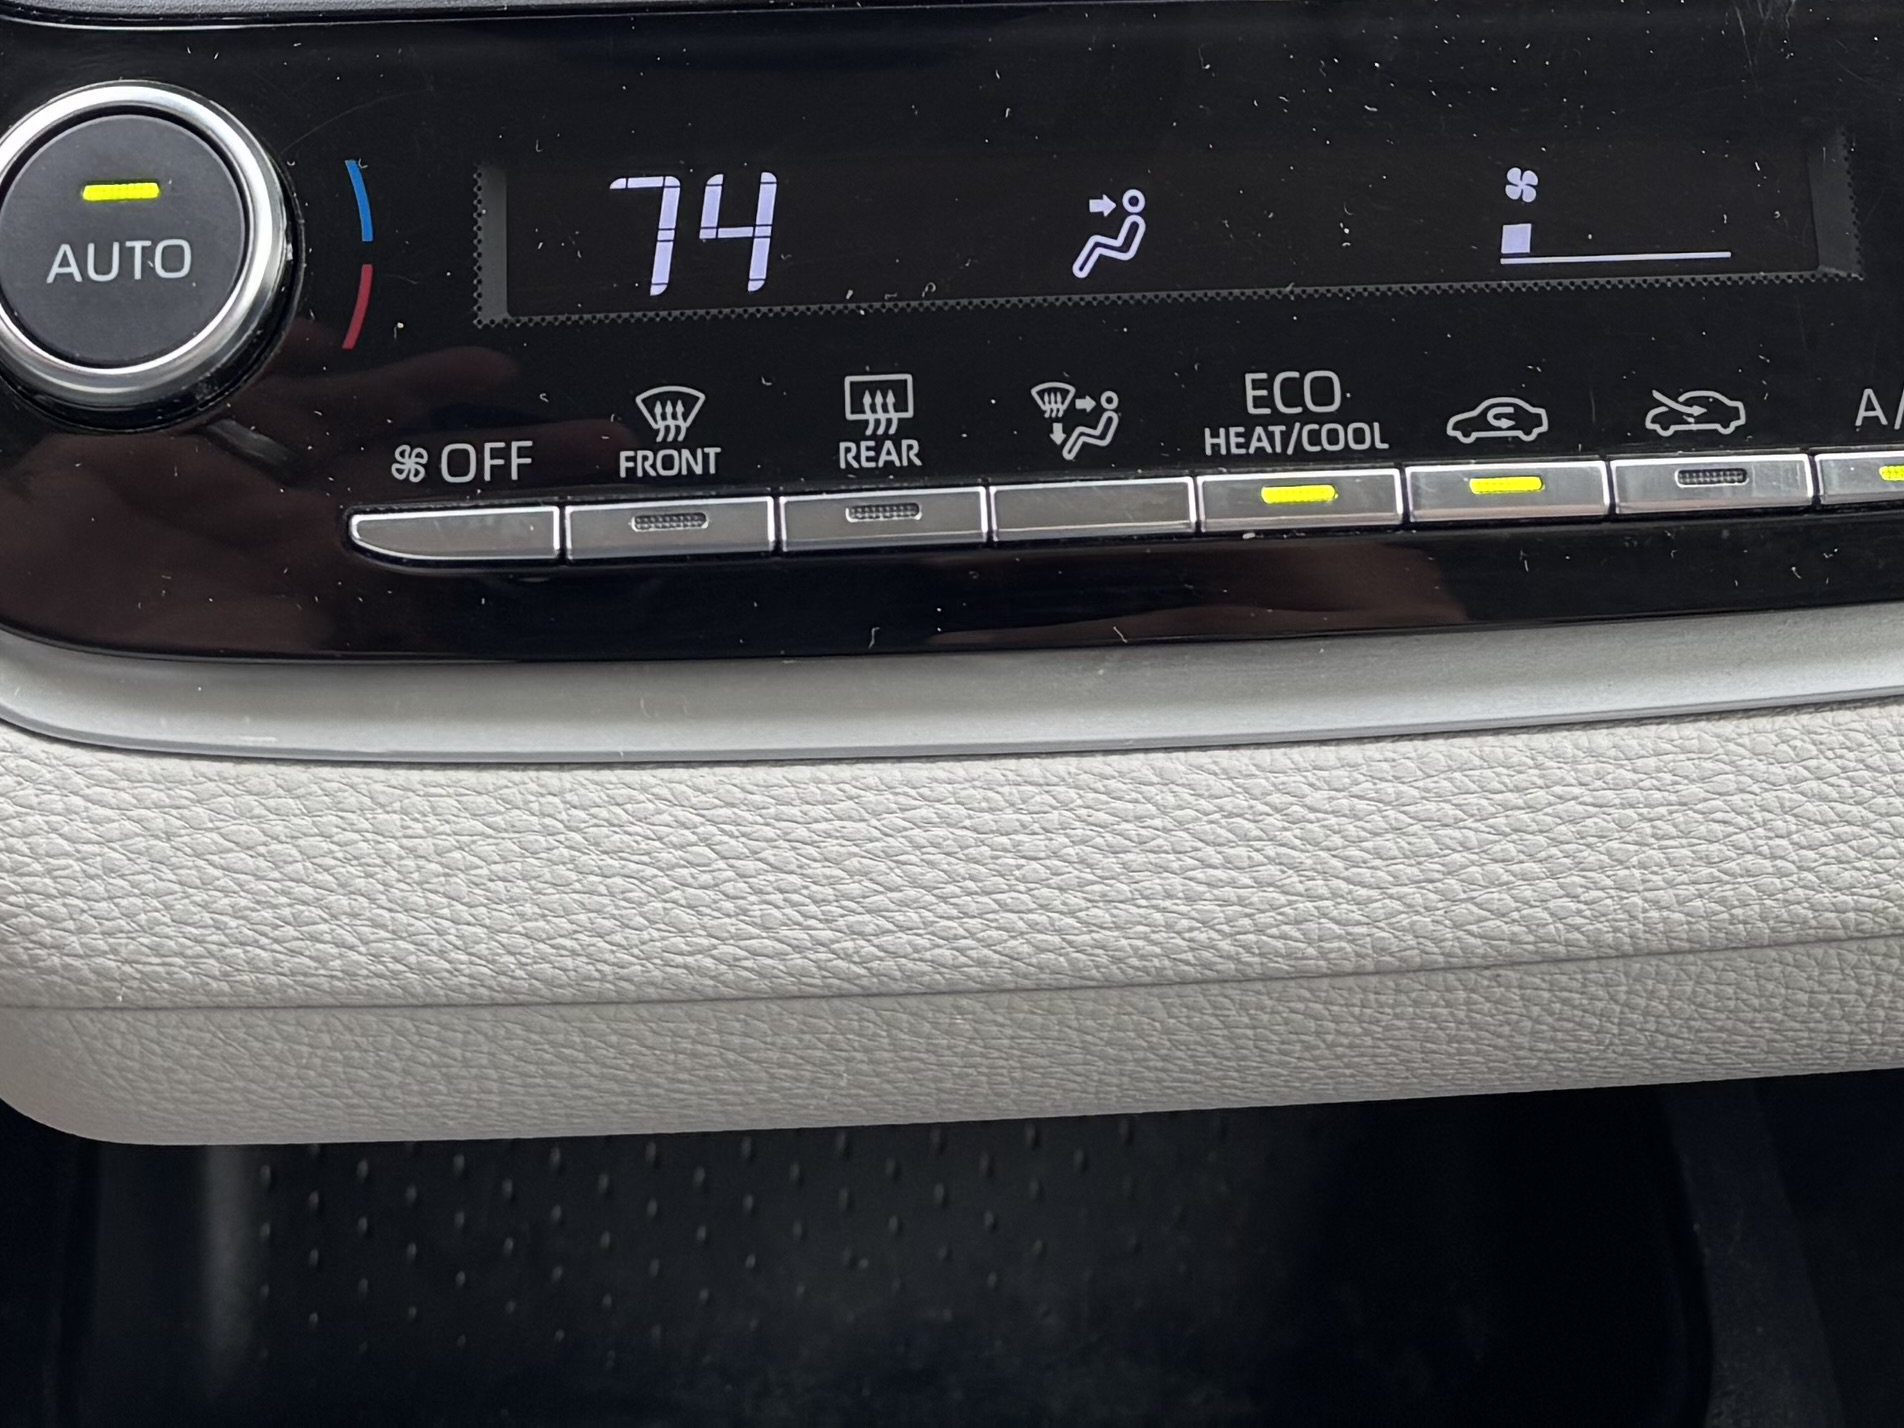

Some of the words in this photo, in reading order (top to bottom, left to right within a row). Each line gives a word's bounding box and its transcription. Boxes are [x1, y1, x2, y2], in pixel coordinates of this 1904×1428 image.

[609, 171, 778, 297] 74
[45, 238, 192, 284] AUTO
[1244, 369, 1343, 416] ECO
[839, 439, 923, 470] REAR
[1203, 421, 1390, 456] HEAT/COOL
[441, 440, 534, 484] OFF
[619, 446, 722, 478] FRONT
